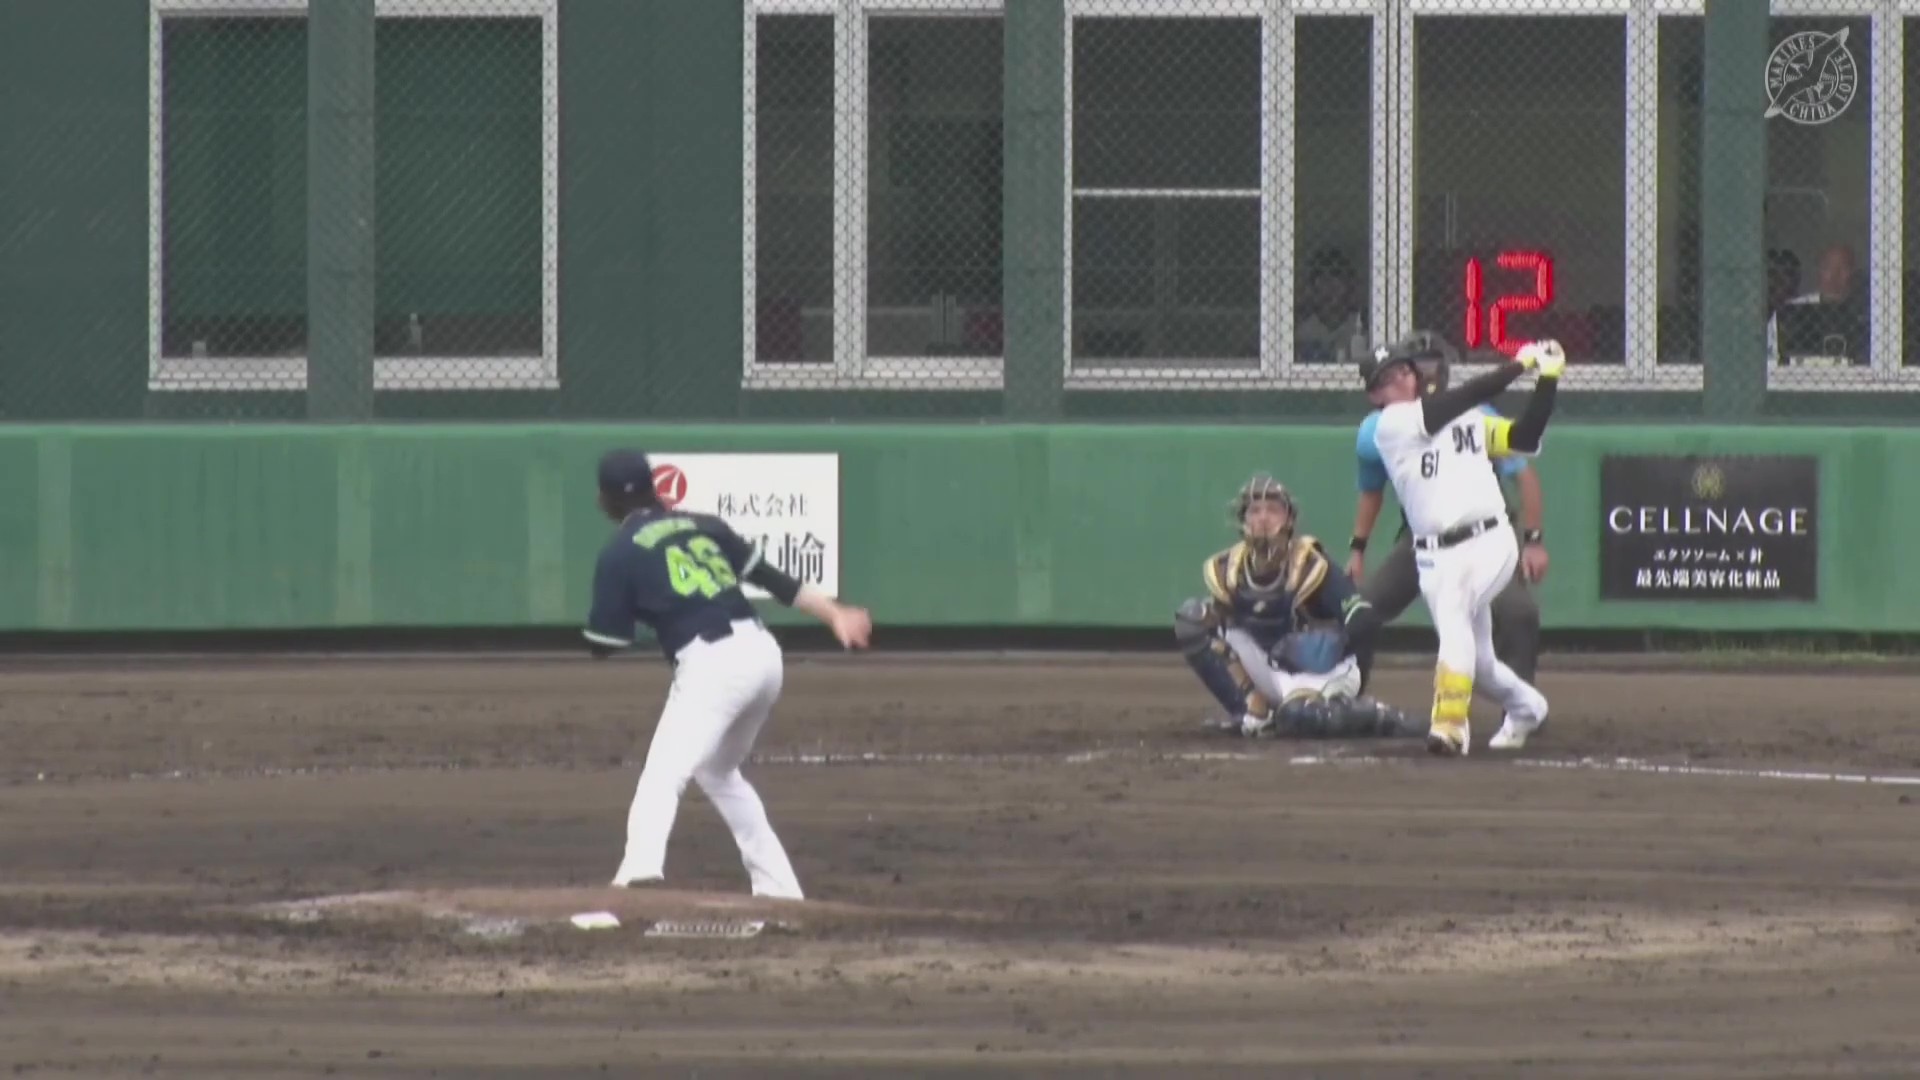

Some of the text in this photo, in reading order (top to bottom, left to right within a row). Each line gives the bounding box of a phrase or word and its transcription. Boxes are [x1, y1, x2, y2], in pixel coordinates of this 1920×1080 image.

[1465, 252, 1553, 359] 12
[1421, 450, 1439, 478] 61
[716, 492, 808, 517] 株式会社
[1609, 506, 1808, 534] CELLNAGE
[1636, 568, 1780, 588] 最先端美容化粧品
